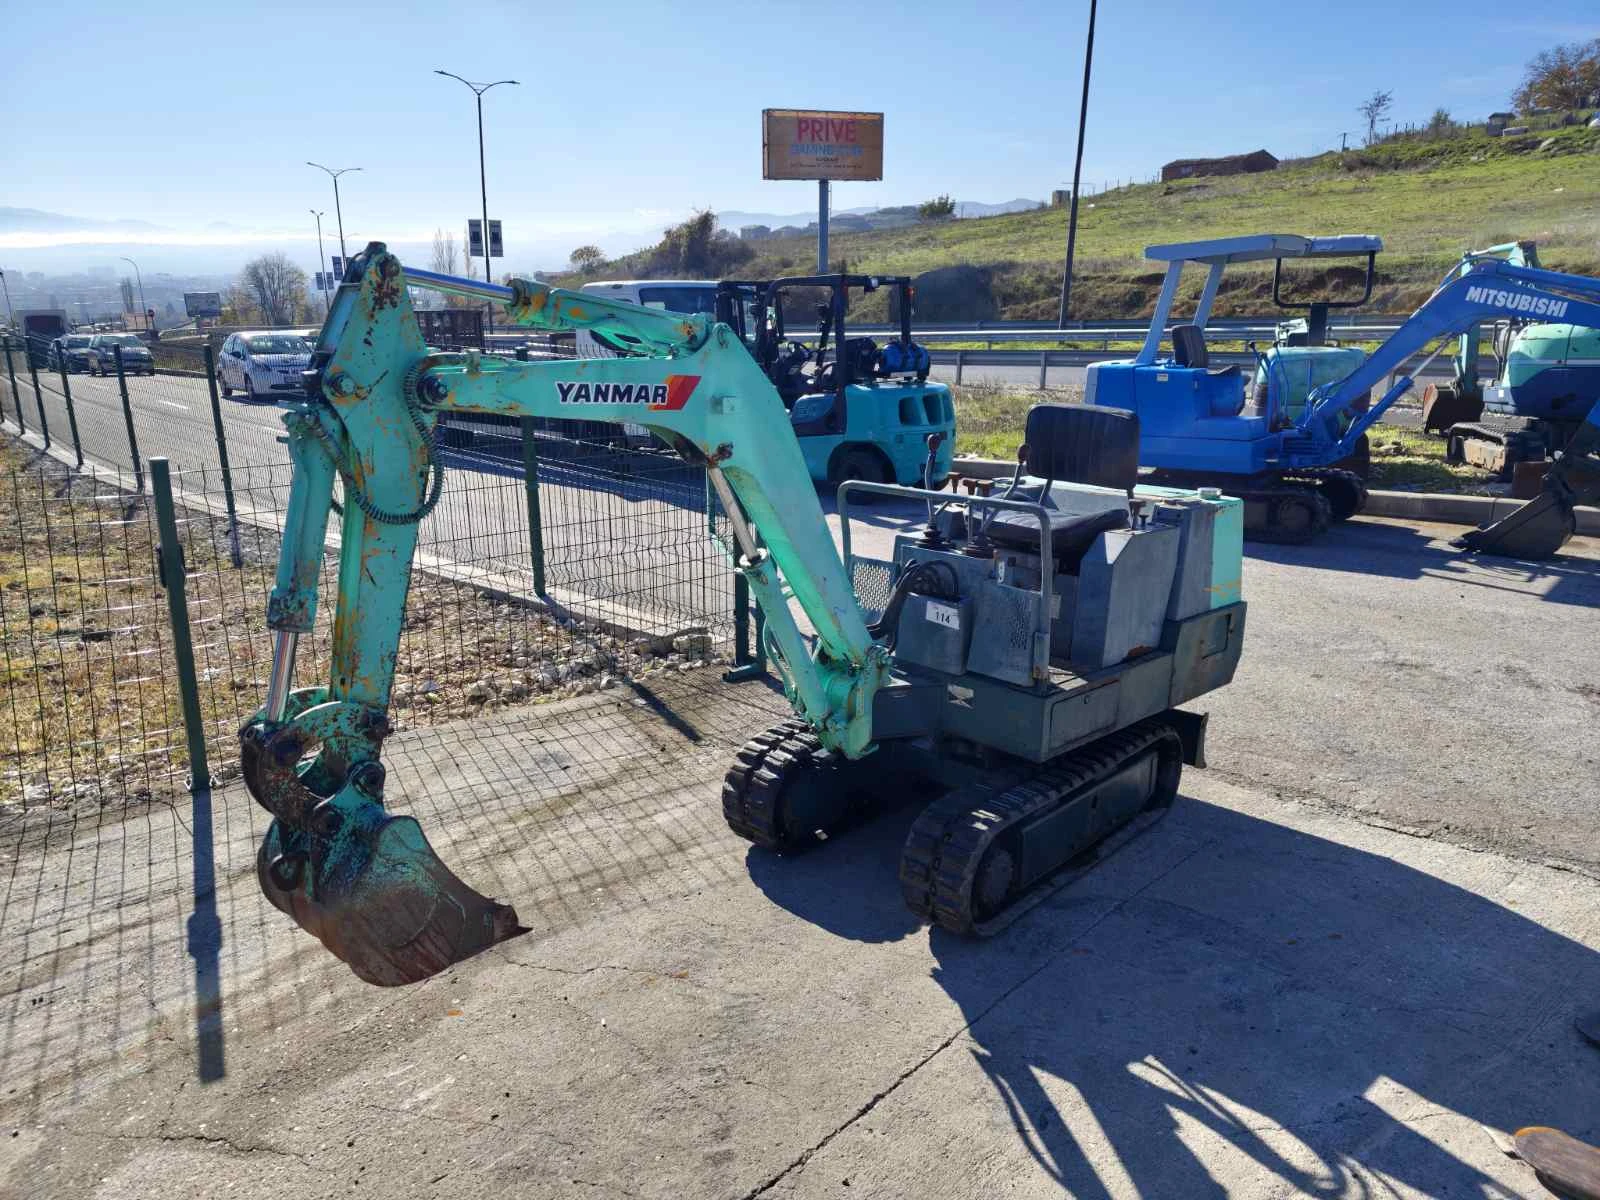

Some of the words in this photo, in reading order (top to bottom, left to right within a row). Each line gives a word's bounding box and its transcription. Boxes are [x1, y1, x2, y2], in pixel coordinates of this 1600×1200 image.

[1465, 286, 1569, 318] MITSUBISHI
[555, 381, 669, 405] YANMAR
[935, 611, 951, 624] 114
